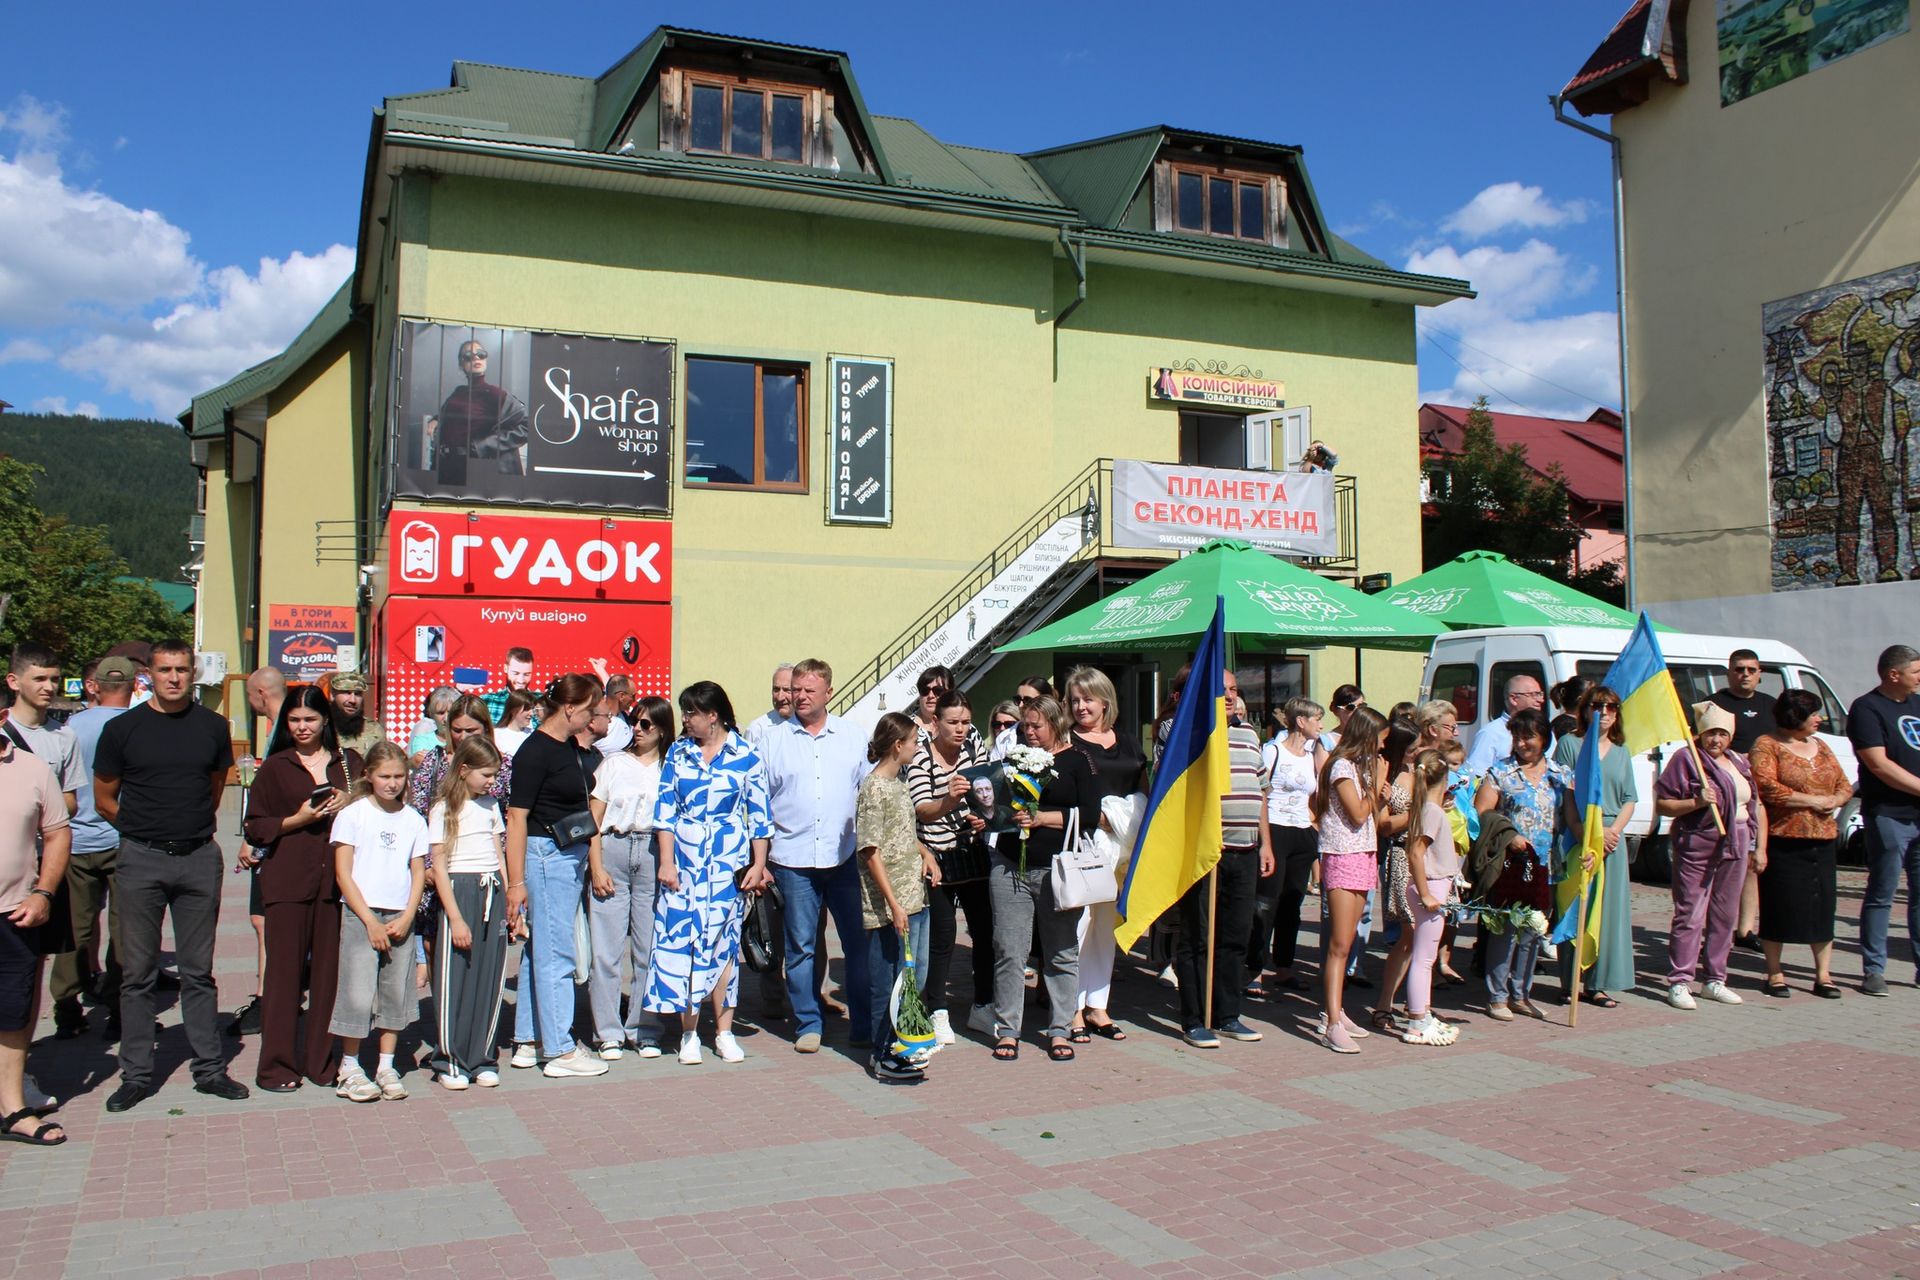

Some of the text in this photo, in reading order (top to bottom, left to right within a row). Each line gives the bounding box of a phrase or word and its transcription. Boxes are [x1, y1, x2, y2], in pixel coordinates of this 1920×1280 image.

[856, 375, 879, 398] ТУРЦІЯ
[1183, 376, 1277, 398] КОМІСІЙНИЙ
[534, 367, 659, 445] Shafa
[841, 366, 851, 442] НОВИЙ
[1203, 392, 1235, 403] ТОВАРИ
[1245, 397, 1277, 407] ЄВРОПИ
[599, 426, 658, 441] woman
[856, 426, 878, 448] ЄВРОПА
[618, 438, 658, 456] shop
[840, 451, 851, 510] ОДЯГ
[1166, 475, 1288, 503] ПЛАНЕТА
[857, 480, 880, 504] БРЕНДИ
[1134, 501, 1319, 535] СЕКОНД-ХЕНД
[1034, 543, 1069, 552] ПОСТІЛЬНА
[1159, 534, 1206, 545] ЯКІСНИЙ
[451, 535, 661, 586] ГУДОК
[1019, 564, 1050, 572] РУШНИКИ
[1034, 554, 1061, 562] БІЛИЗНА
[1010, 574, 1033, 582] ШАПКИ
[291, 608, 332, 618] В ГОРИ
[481, 607, 587, 624] Купуй вигідно
[274, 619, 347, 629] НА ДЖИПАХ
[895, 630, 949, 683] ЖІНОЧИЙ ОДЯГ
[942, 645, 961, 665] ОДЯГ
